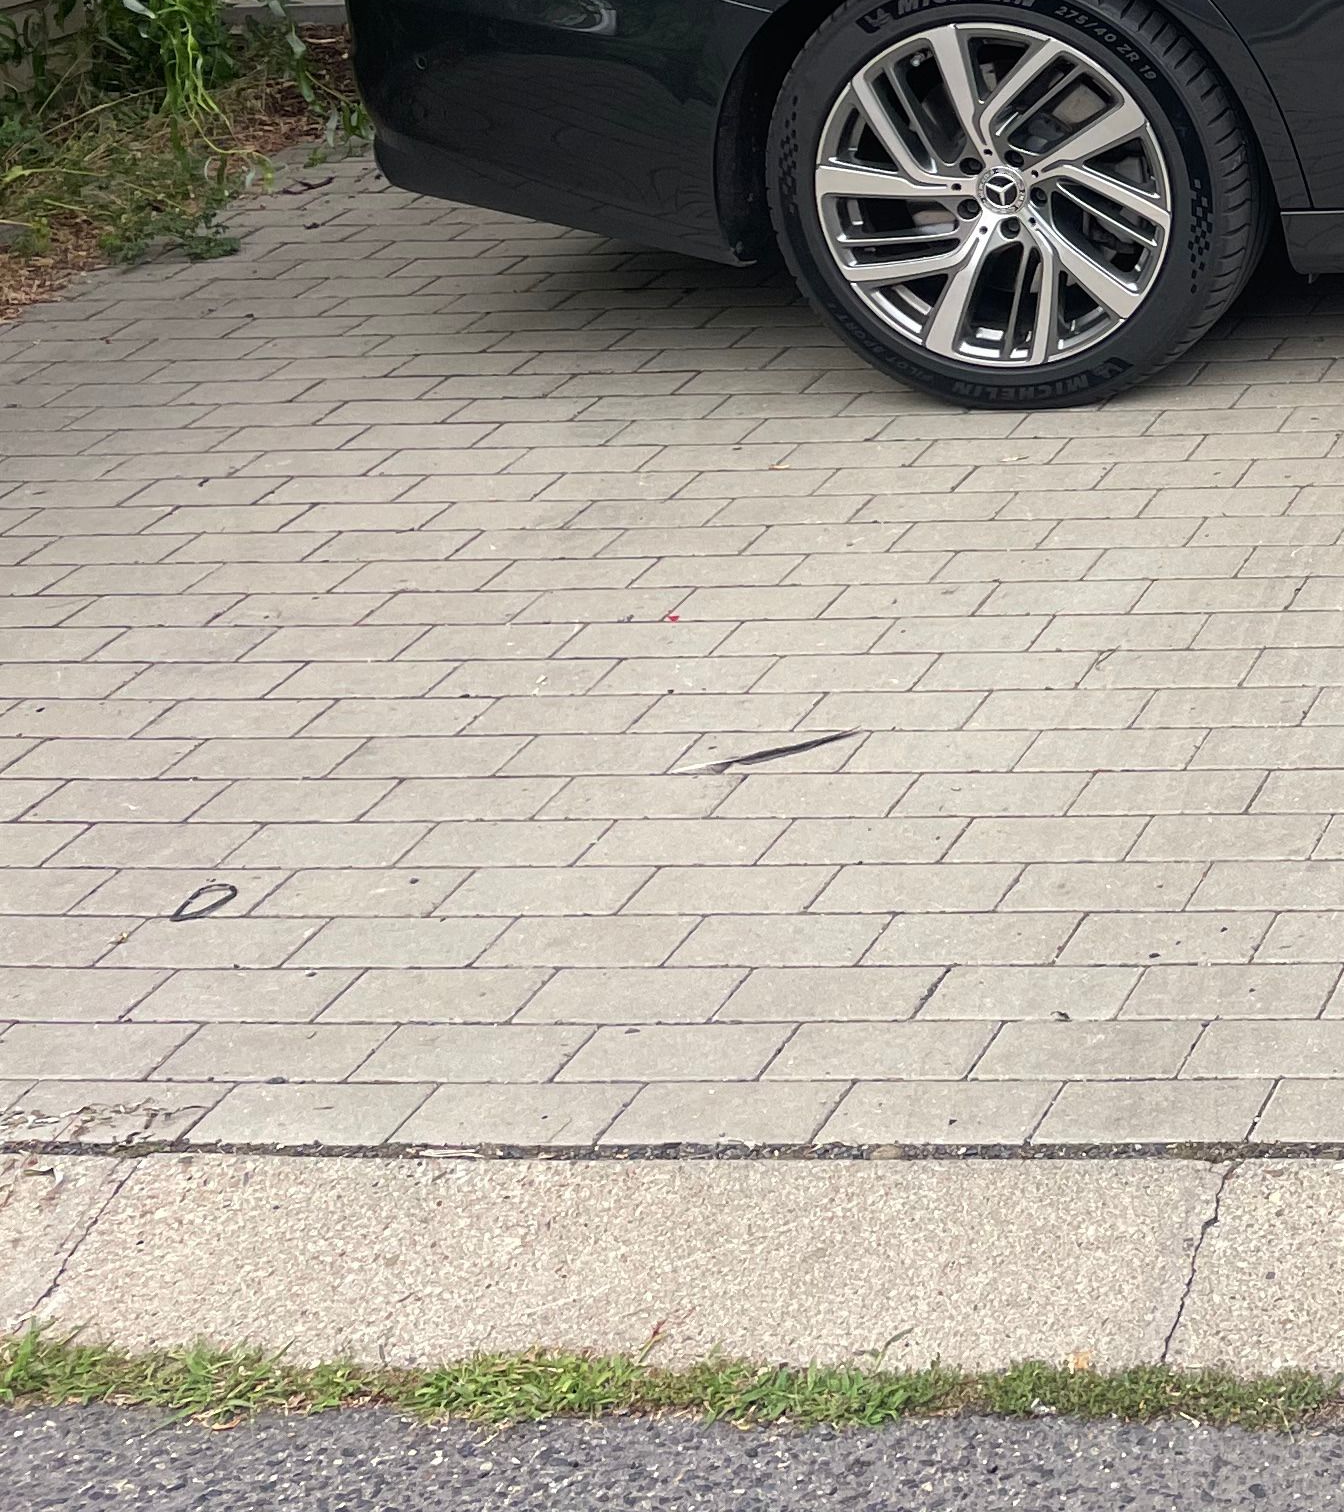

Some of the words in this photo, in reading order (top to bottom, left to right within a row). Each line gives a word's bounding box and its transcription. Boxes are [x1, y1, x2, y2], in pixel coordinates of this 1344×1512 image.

[1054, 6, 1117, 42] 275/40
[1116, 43, 1140, 62] ZR
[1140, 64, 1157, 80] 19
[952, 374, 1089, 400] MICHELIN
